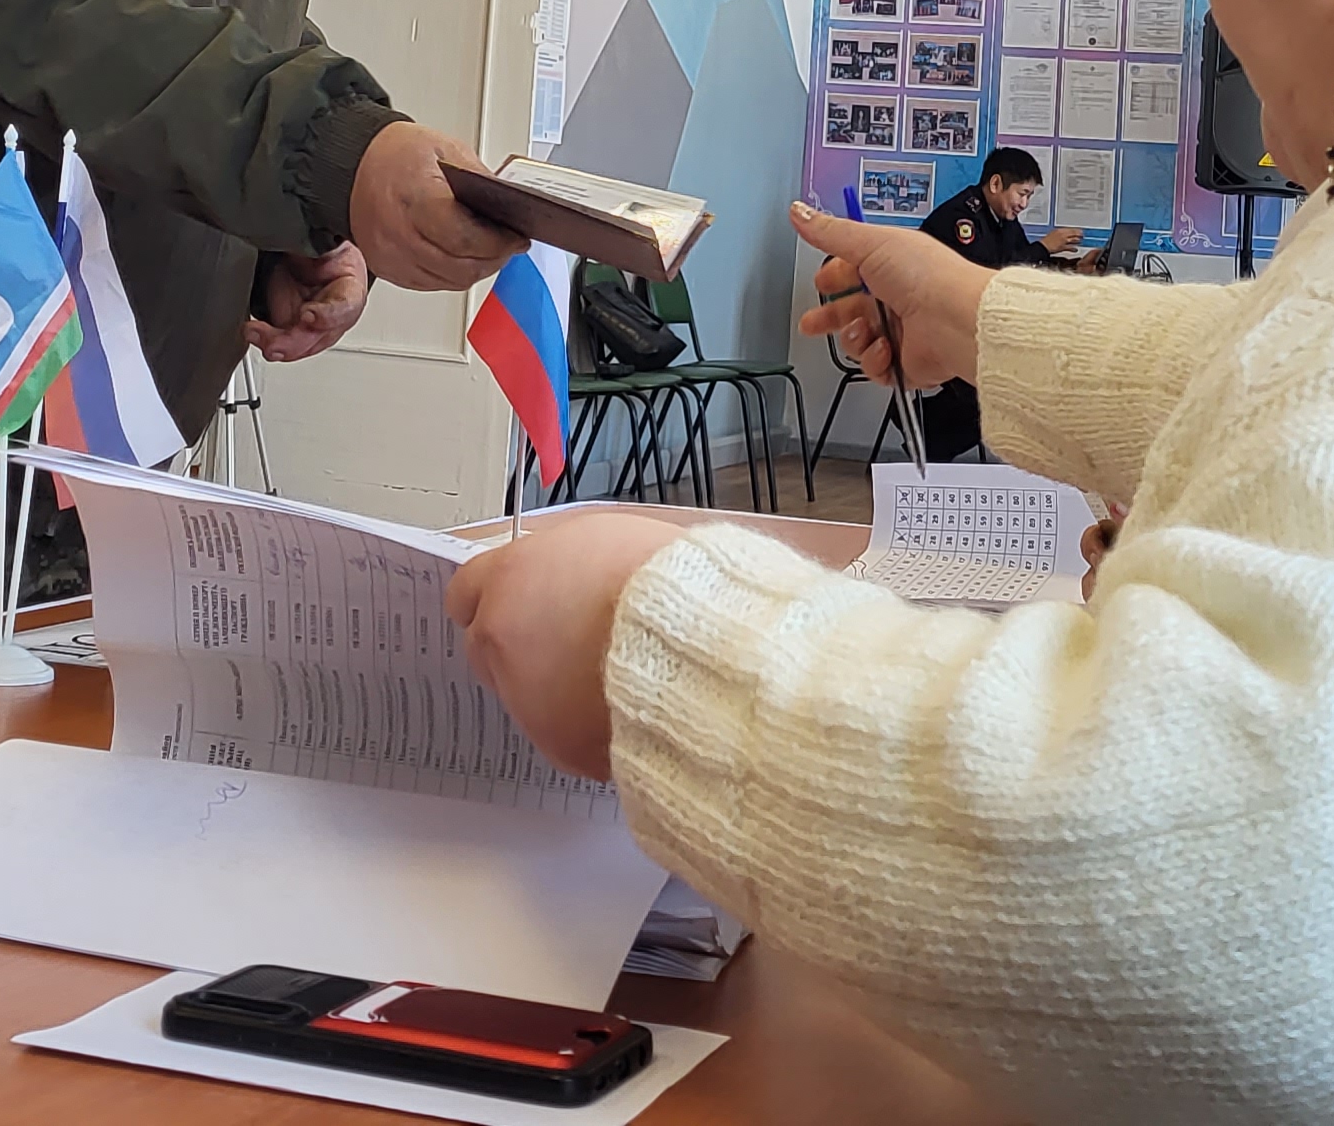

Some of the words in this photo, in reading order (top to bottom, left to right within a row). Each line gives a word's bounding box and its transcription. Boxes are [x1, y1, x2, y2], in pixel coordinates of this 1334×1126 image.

[933, 493, 939, 503] 30
[949, 494, 955, 504] 40
[964, 494, 972, 504] 50
[980, 494, 987, 504] 60
[996, 495, 1003, 504] 70
[1013, 496, 1019, 505] 80
[1029, 496, 1035, 506] 90
[964, 516, 971, 525] 49
[980, 516, 987, 526] 59
[996, 517, 1003, 526] 69
[1013, 517, 1019, 527] 79
[1045, 518, 1052, 528] 99
[978, 538, 985, 547] 58
[1011, 539, 1018, 548] 78
[1028, 540, 1034, 549] 88
[1044, 540, 1051, 550] 98
[1042, 562, 1049, 571] 97
